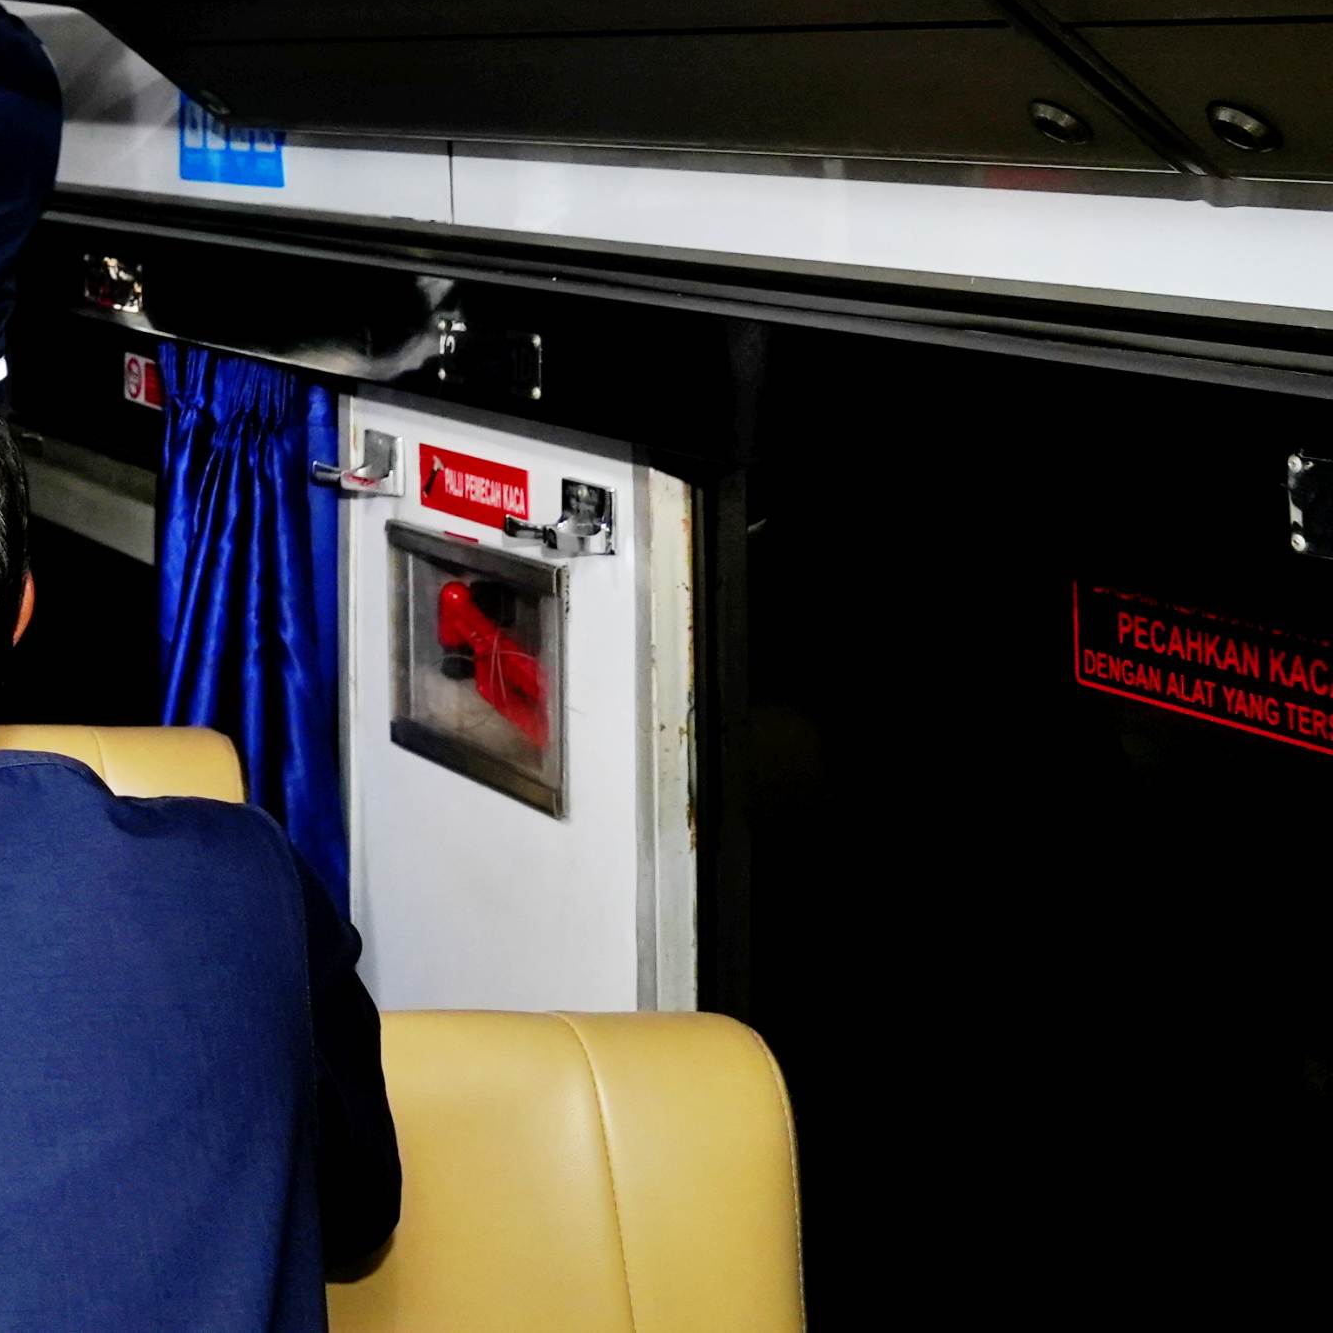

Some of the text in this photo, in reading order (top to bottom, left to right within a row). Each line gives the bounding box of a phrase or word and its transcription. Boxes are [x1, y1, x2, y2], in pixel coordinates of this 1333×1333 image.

[444, 467, 526, 515] PALU PEMECAH KACA
[1084, 649, 1161, 692] DENGAN
[1166, 672, 1215, 708] ALAT
[1222, 685, 1279, 726] YANG
[1117, 612, 1333, 696] PECAHKAN KAC
